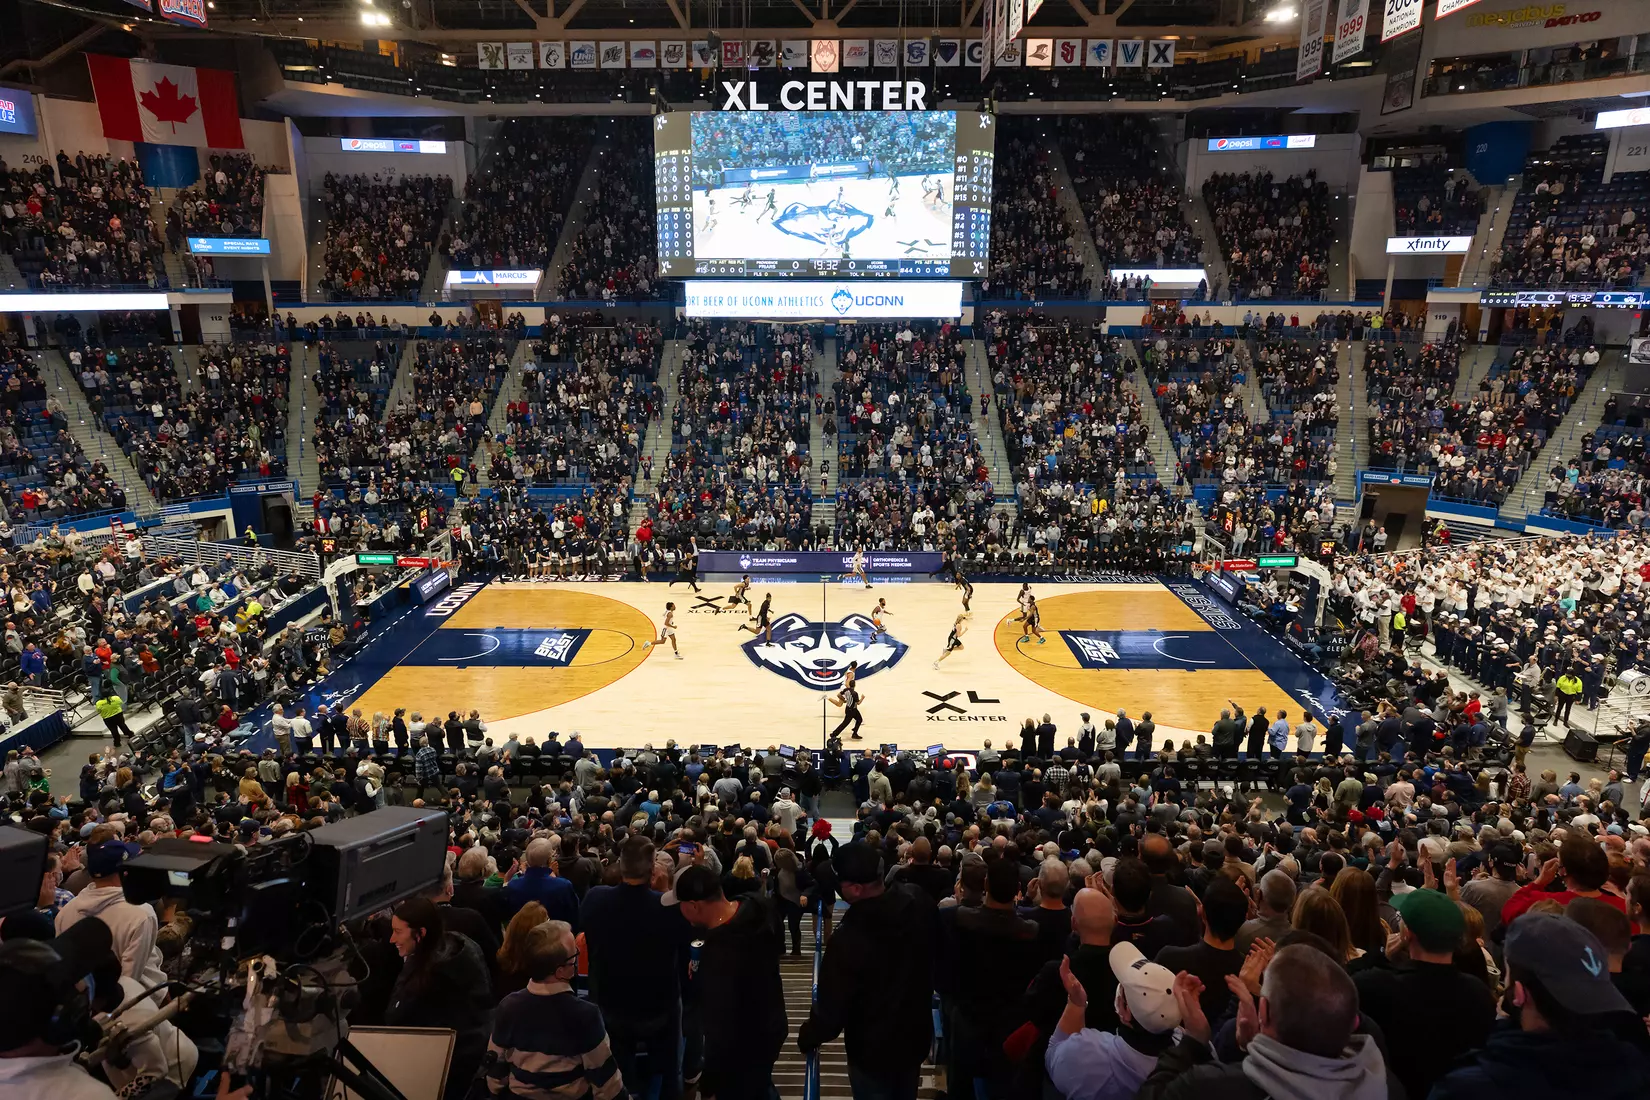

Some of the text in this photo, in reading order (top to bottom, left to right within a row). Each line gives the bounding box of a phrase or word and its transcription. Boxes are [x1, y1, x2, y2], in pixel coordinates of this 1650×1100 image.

[1389, 8, 1415, 25] NATIONAL
[1466, 4, 1566, 28] megabus
[1339, 15, 1363, 40] 1999
[1386, 18, 1416, 37] CHAMPIONS
[1302, 37, 1322, 59] 1995
[1338, 38, 1359, 50] NATIONAL
[1152, 44, 1171, 63] X
[722, 80, 926, 110] XL CENTER
[363, 142, 386, 150] pepsi
[1229, 140, 1252, 148] pepsi
[1476, 143, 1488, 154] 220
[1627, 146, 1647, 157] 221
[23, 154, 43, 164] 240
[1407, 238, 1450, 251] xfinity
[792, 261, 800, 269] 0
[814, 261, 838, 270] 19:32
[849, 261, 855, 269] 0
[704, 296, 824, 307] BEER OF UCONN ATHLETICS
[855, 295, 903, 306] UCONN
[425, 582, 481, 616] UCONN
[1168, 584, 1242, 630] HUSKIES
[534, 637, 558, 657] BIG
[547, 633, 574, 660] EAST
[1092, 640, 1120, 659] BIG
[921, 691, 1000, 714] XL
